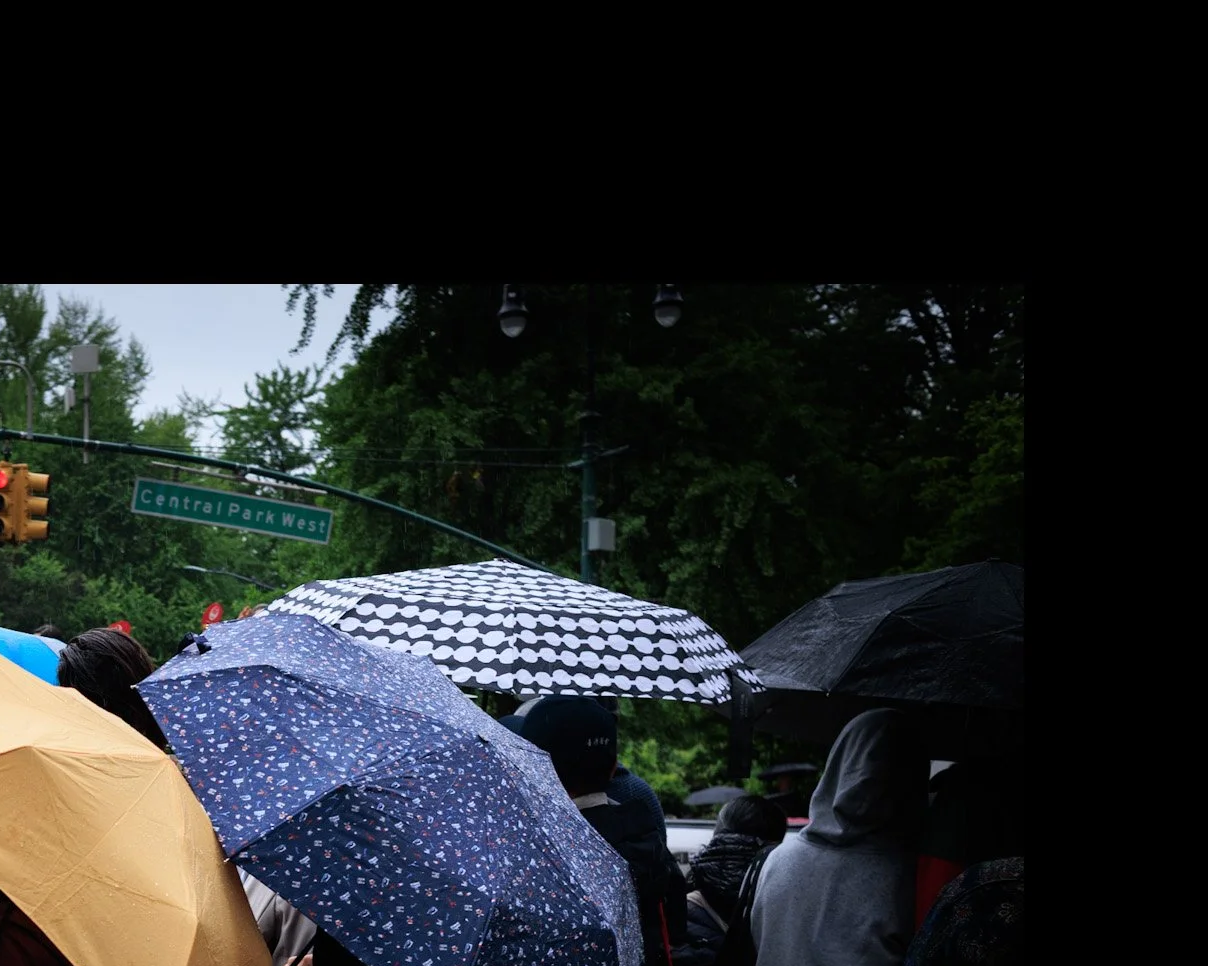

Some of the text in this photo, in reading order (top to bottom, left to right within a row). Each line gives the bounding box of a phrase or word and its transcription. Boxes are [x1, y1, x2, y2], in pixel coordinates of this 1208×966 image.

[140, 488, 326, 534] Central Park West
